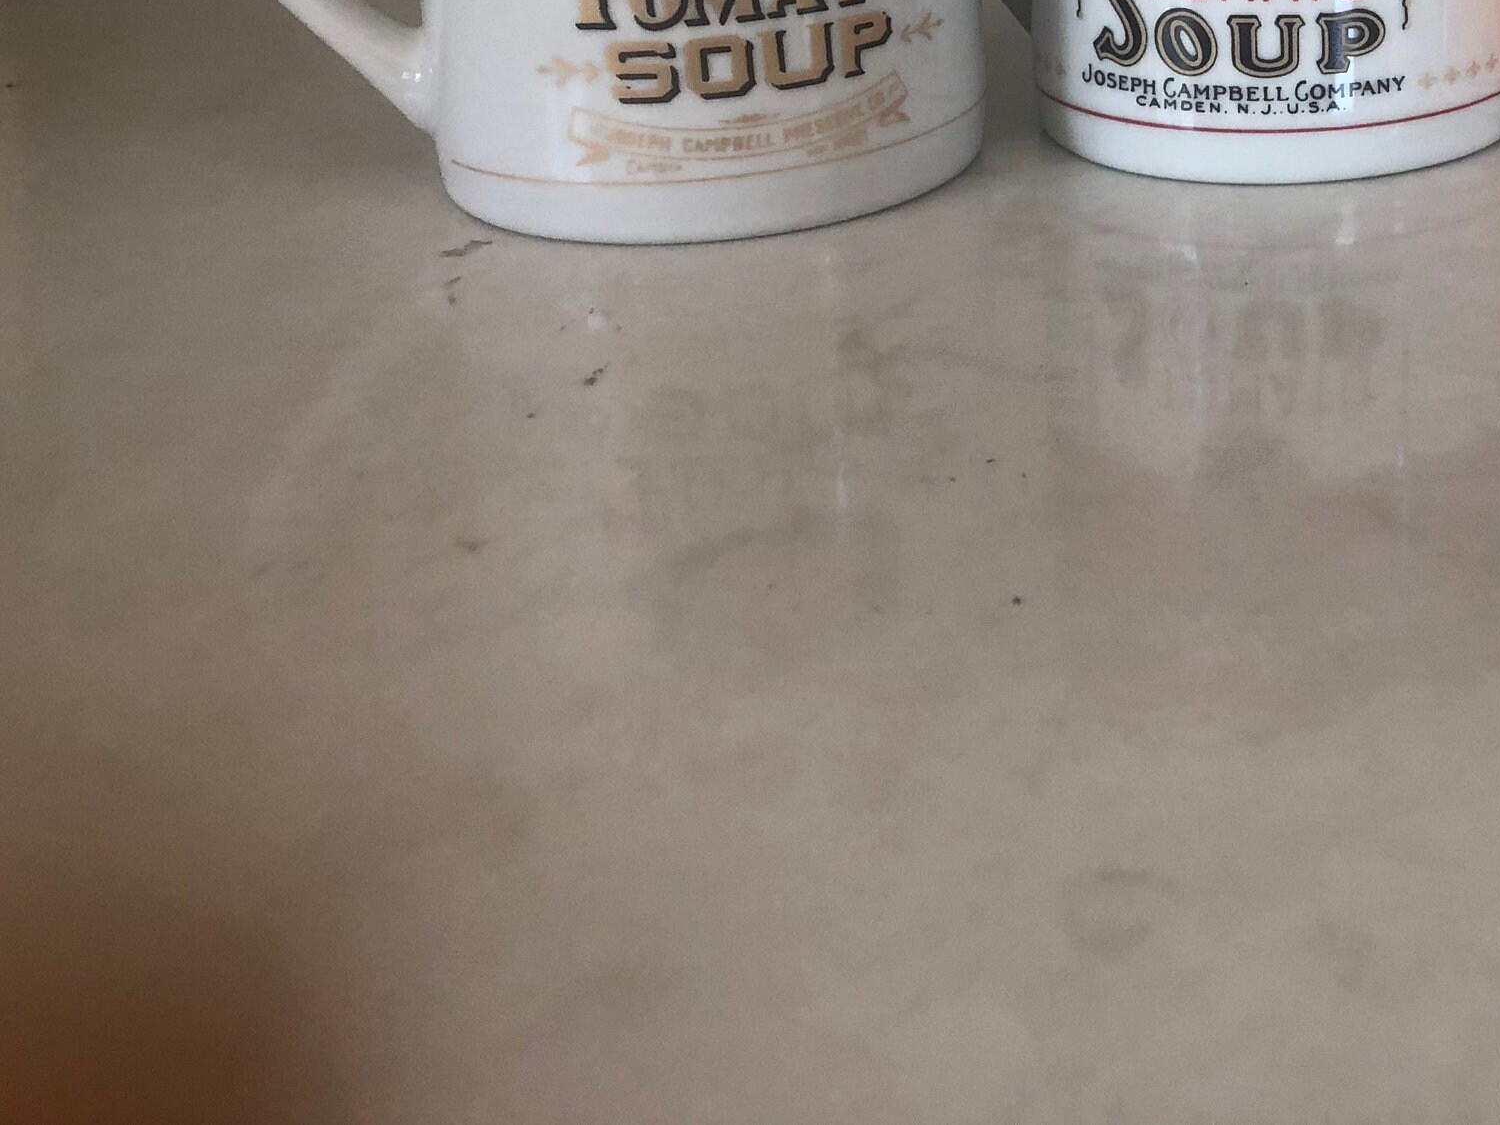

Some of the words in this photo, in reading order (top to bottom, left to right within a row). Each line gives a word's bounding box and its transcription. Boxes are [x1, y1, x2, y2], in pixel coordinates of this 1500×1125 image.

[603, 9, 894, 105] SOUP
[1081, 63, 1157, 96] JOSEPH
[1163, 77, 1290, 103] CAMPBELL
[1294, 75, 1407, 102] COMPANY
